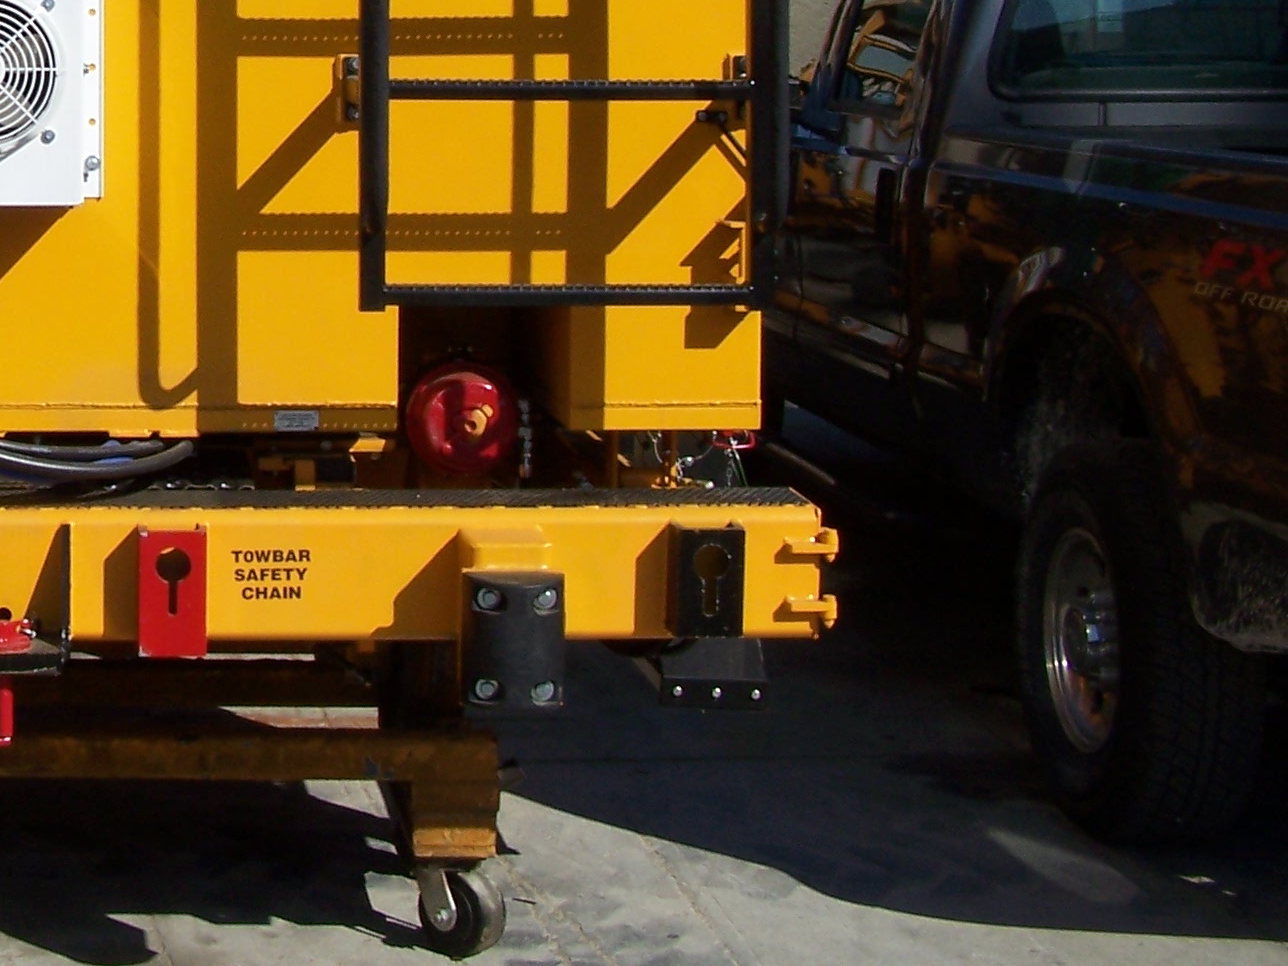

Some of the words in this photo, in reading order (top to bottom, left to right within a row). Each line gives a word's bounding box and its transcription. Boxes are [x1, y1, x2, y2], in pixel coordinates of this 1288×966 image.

[1201, 239, 1288, 290] FX
[1194, 281, 1234, 301] OFF
[231, 549, 311, 563] TOWBAR
[234, 567, 308, 582] SAFETY
[241, 586, 302, 600] CHAIN
